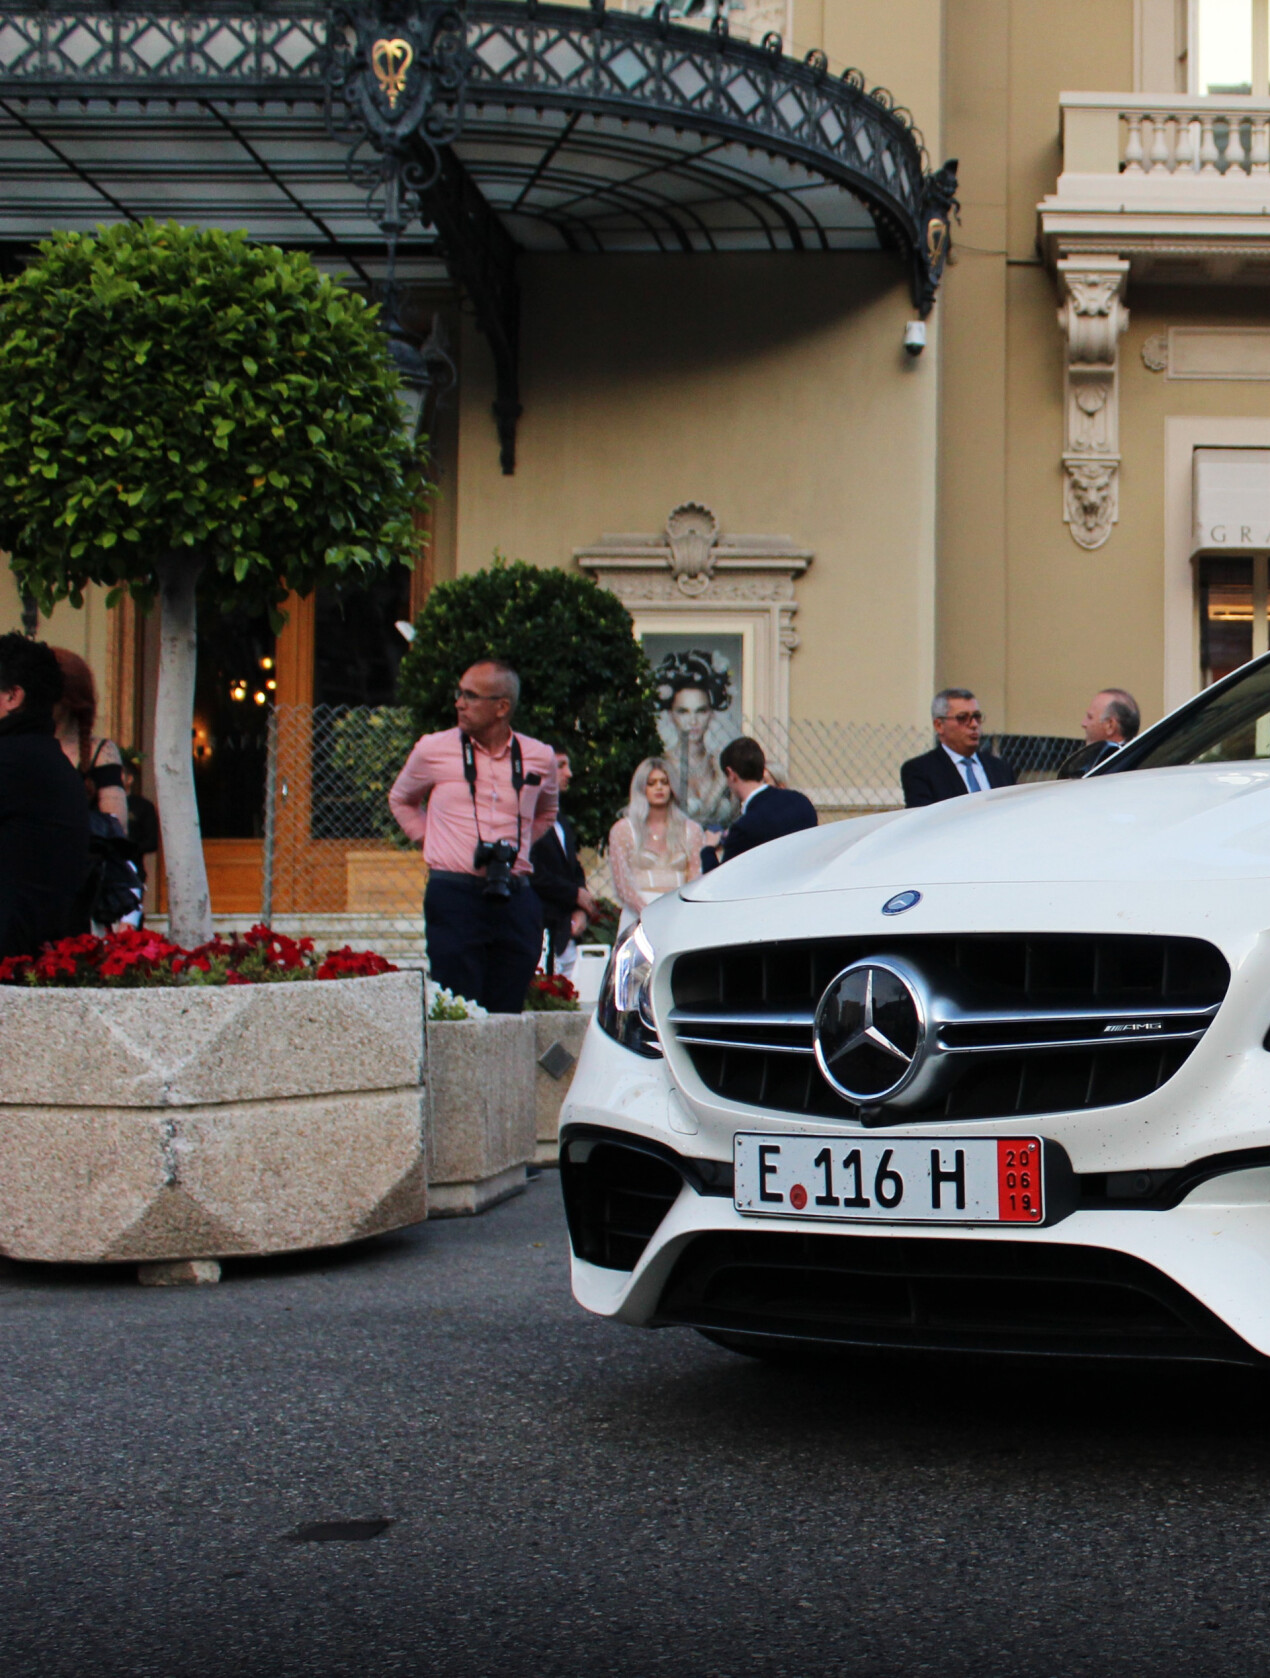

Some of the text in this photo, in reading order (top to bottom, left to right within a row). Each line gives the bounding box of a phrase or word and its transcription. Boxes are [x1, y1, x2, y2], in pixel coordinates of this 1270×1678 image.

[1122, 1022, 1162, 1032] AMG
[1006, 1150, 1030, 1168] 20
[758, 1144, 966, 1210] E 116 H
[1006, 1172, 1031, 1189] 06
[1010, 1194, 1032, 1212] 19
